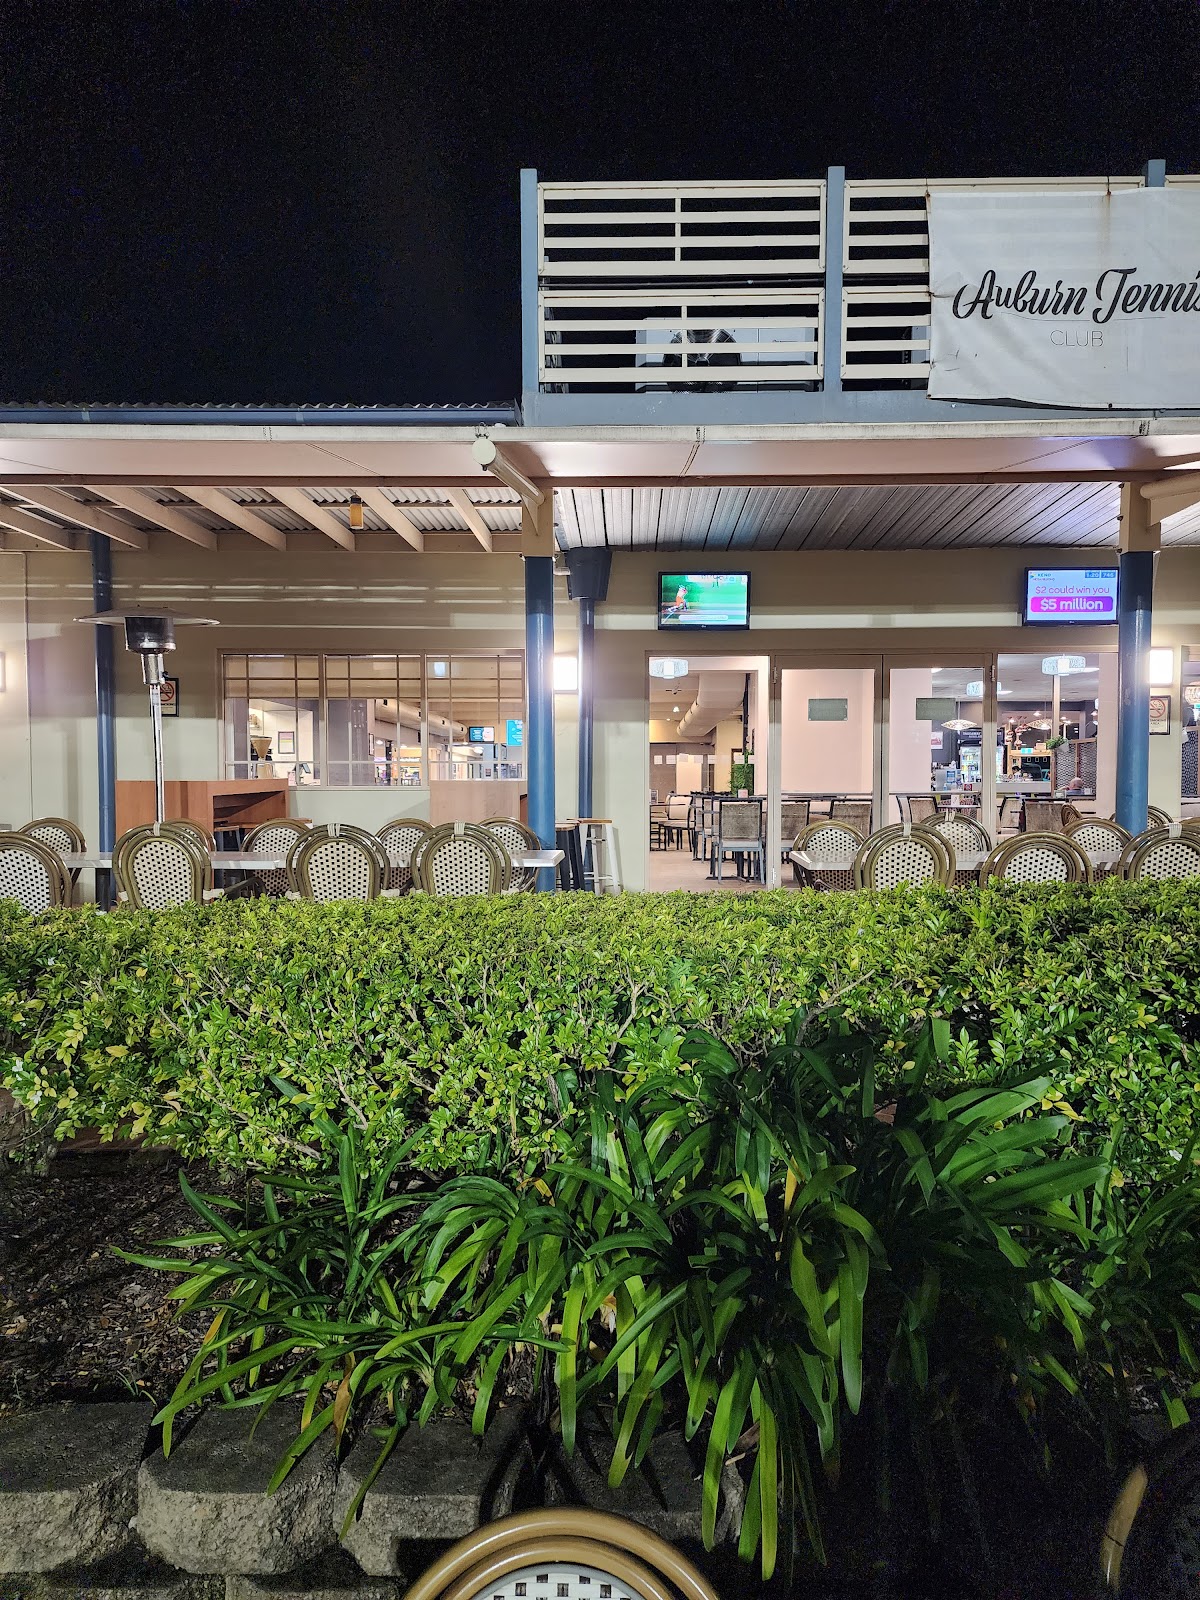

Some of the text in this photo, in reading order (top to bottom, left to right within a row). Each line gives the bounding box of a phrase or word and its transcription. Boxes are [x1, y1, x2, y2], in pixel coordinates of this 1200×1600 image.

[952, 269, 1088, 320] Auburn
[1050, 329, 1104, 347] CLUB
[1035, 585, 1110, 595] $2 could win you
[1040, 597, 1104, 611] $5 million
